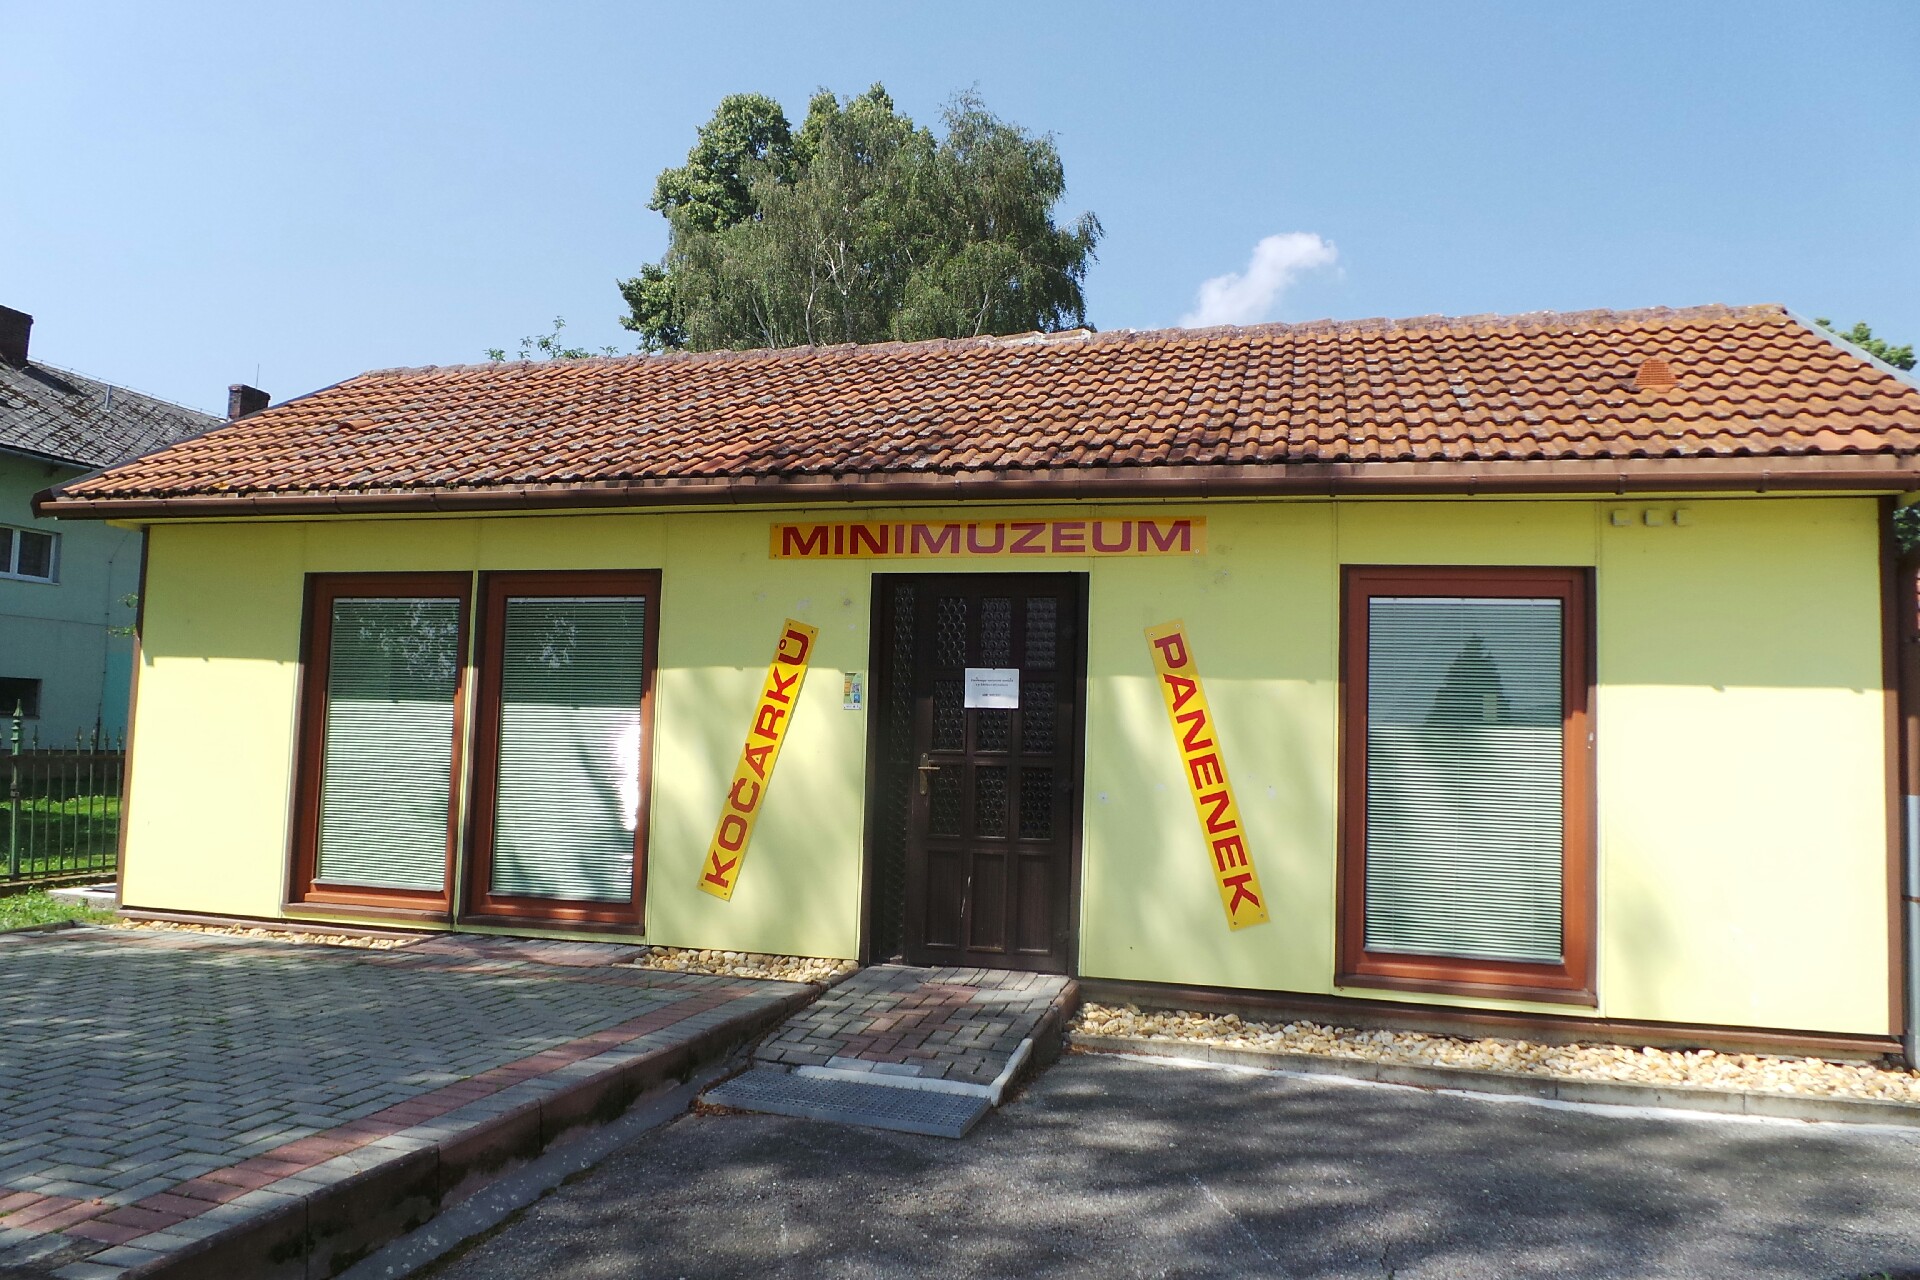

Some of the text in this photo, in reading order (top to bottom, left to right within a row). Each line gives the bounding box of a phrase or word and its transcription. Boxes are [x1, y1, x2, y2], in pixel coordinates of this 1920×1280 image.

[781, 519, 1191, 556] MINIMUZEUM
[704, 628, 810, 889] KOČÁRKŮ
[1153, 632, 1261, 917] PANENEK
